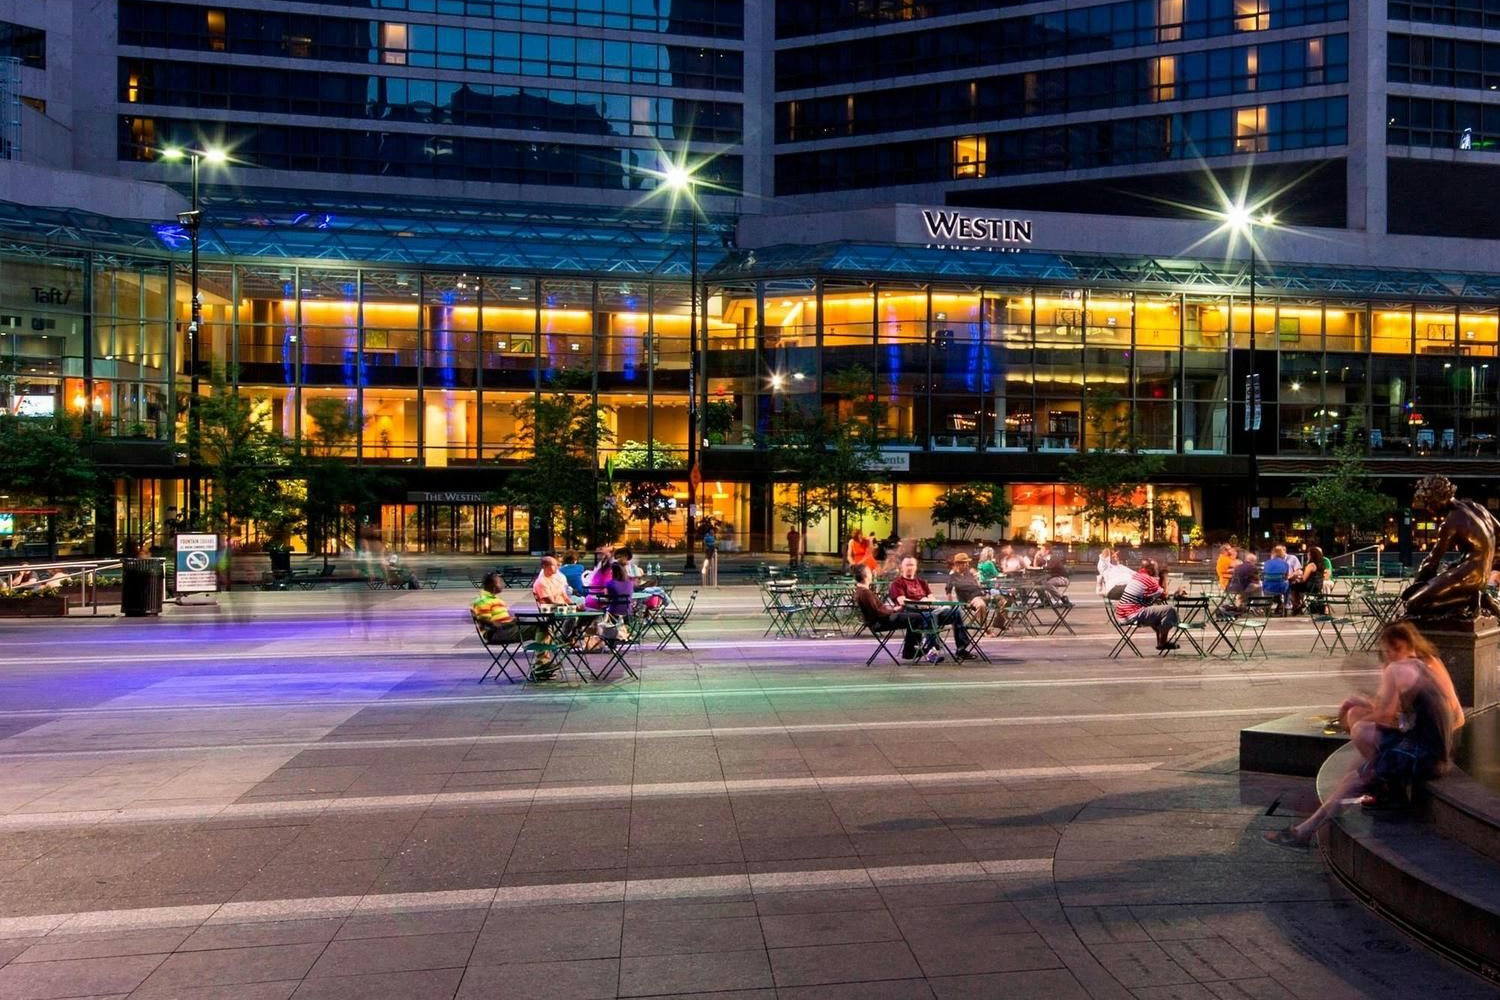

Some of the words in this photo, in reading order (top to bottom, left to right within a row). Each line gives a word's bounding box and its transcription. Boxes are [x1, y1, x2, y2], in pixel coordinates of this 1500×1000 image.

[922, 209, 1032, 243] WESTIN
[424, 492, 442, 501] THE
[444, 492, 481, 501] WESTIN
